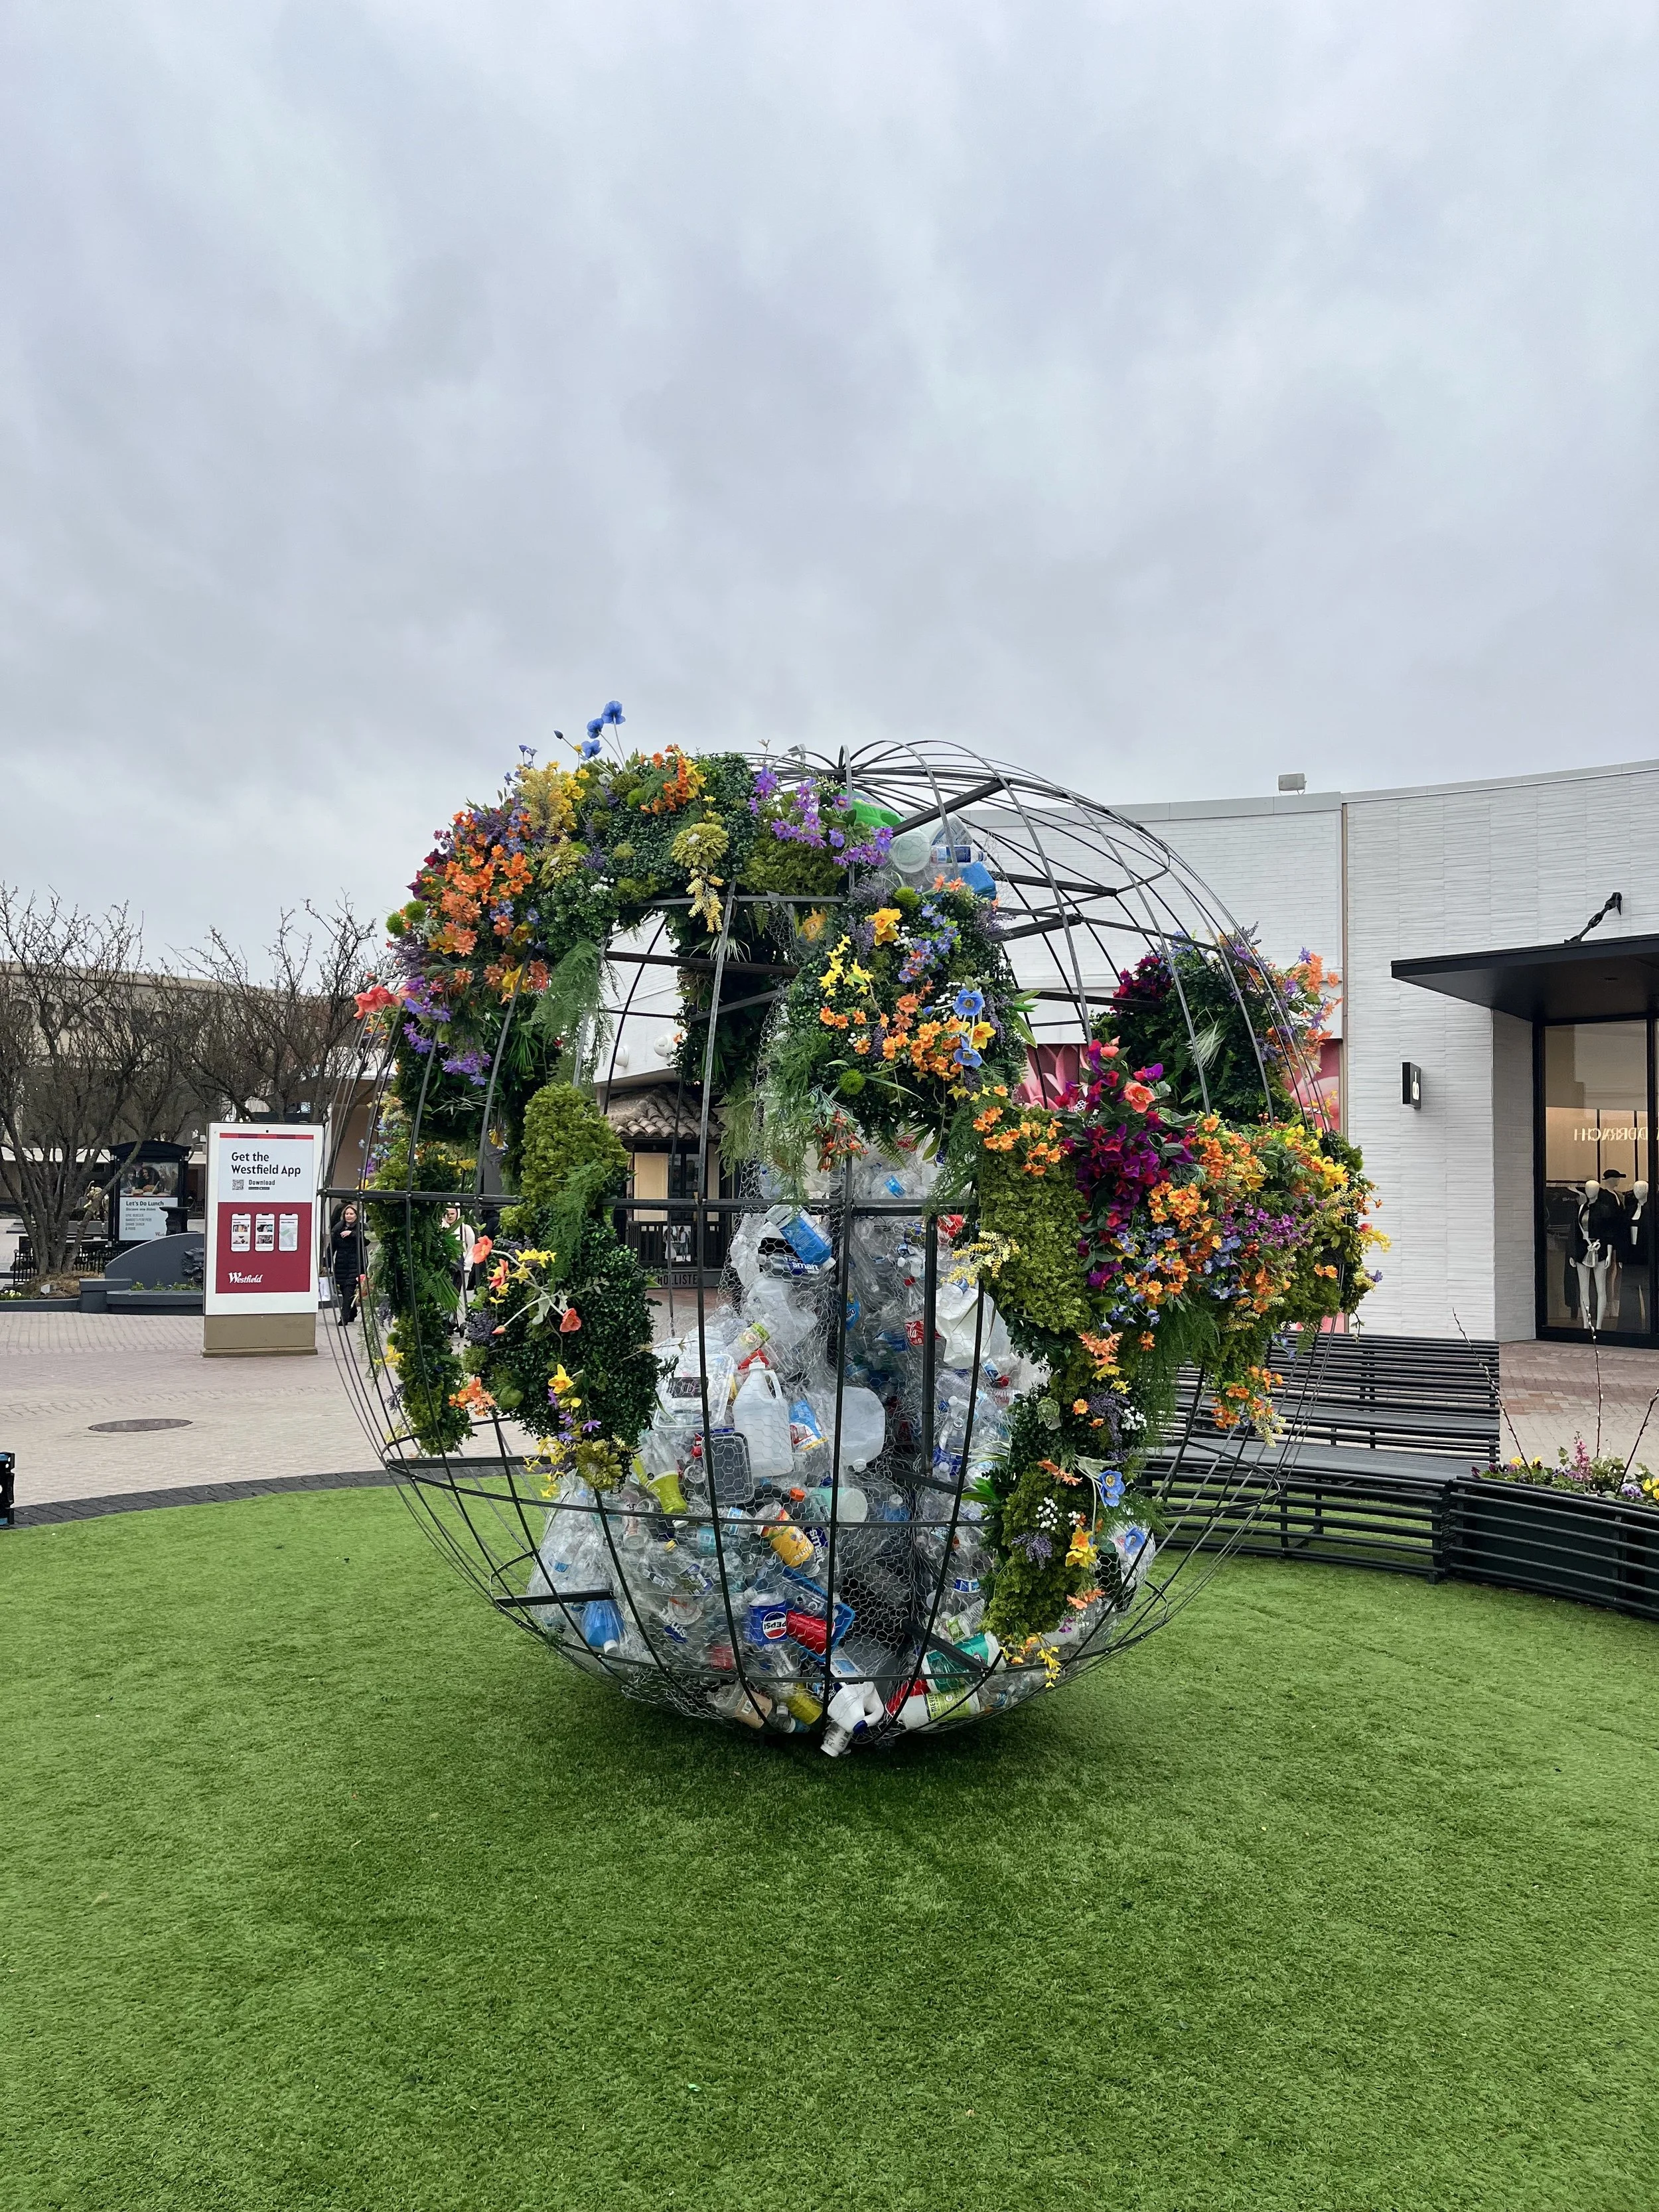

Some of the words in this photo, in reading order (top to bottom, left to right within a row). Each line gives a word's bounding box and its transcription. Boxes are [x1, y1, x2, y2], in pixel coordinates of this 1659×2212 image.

[231, 1151, 250, 1161] Get
[252, 1151, 269, 1161] the
[231, 1164, 279, 1174] Westfield
[281, 1165, 301, 1177] App
[792, 1262, 820, 1271] smart
[228, 1272, 263, 1284] Westfield
[657, 1274, 698, 1286] HOLISTE
[810, 1528, 826, 1563] smart
[764, 1621, 786, 1630] PEPSI
